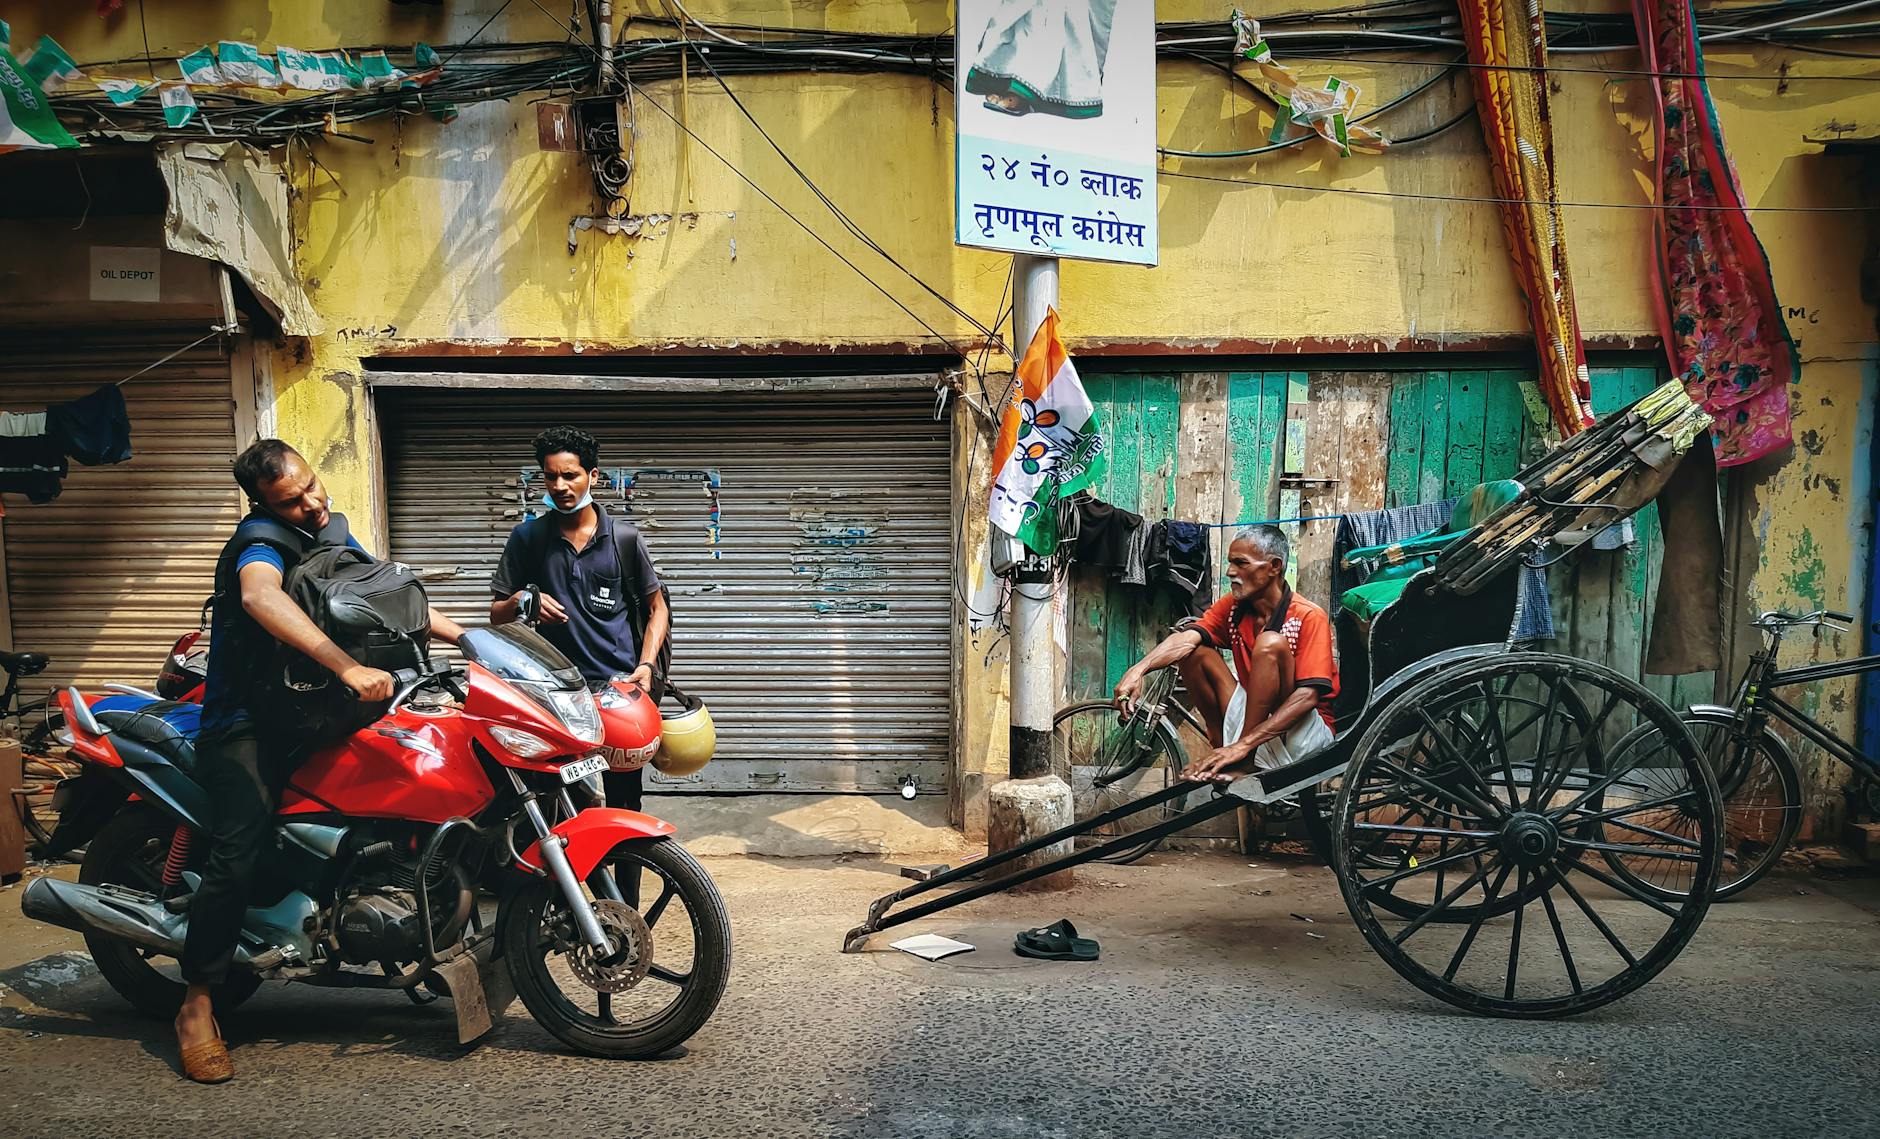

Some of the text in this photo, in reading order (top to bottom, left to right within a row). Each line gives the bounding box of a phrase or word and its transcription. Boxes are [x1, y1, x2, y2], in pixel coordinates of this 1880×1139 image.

[981, 154, 1020, 180] २४
[1080, 169, 1144, 200] ब्लाक
[974, 203, 1146, 247] तृणमूल कांग्रेस
[100, 269, 154, 280] OIL DEPOT
